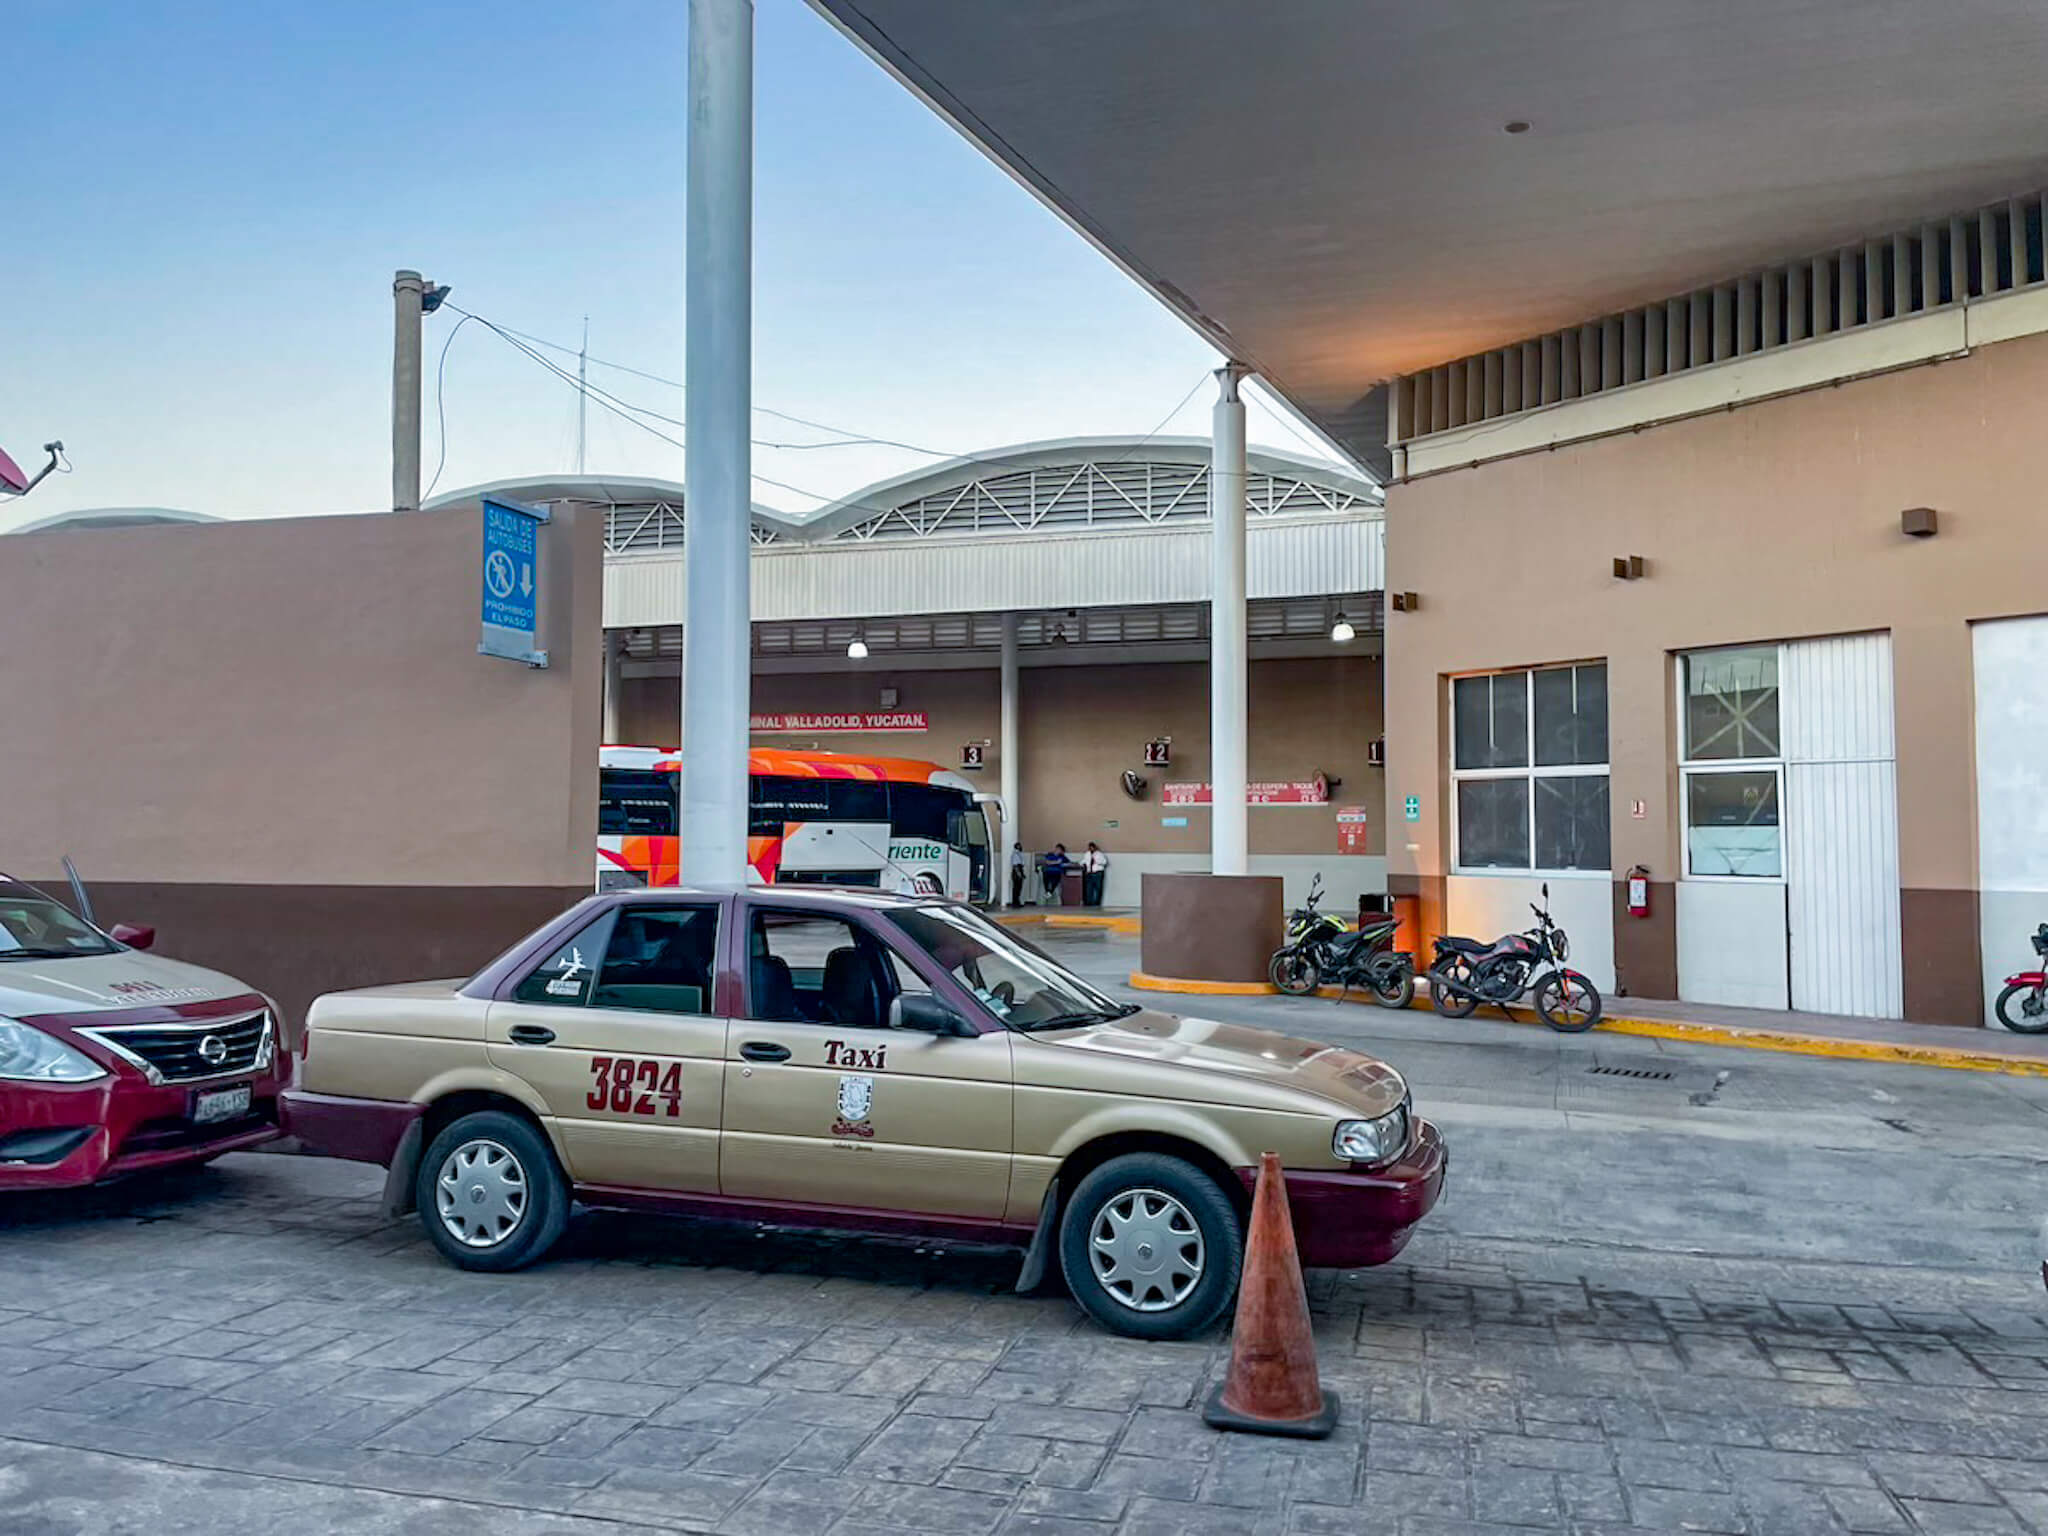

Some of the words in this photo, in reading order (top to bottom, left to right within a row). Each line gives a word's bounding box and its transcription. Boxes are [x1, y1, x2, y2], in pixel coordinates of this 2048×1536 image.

[488, 508, 518, 536] SALIDA
[521, 518, 533, 539] DE
[488, 528, 532, 555] AUTOBUSES
[486, 599, 533, 618] PROHIBIDO
[492, 611, 501, 623] EL
[501, 613, 527, 629] PASO
[784, 714, 863, 729] VALLADOLID,
[866, 713, 926, 727] YUCATAN.
[969, 747, 978, 764] 3
[1156, 744, 1166, 761] 2
[887, 843, 942, 860] riente
[823, 1040, 887, 1069] Taxi
[586, 1056, 682, 1117] 3824
